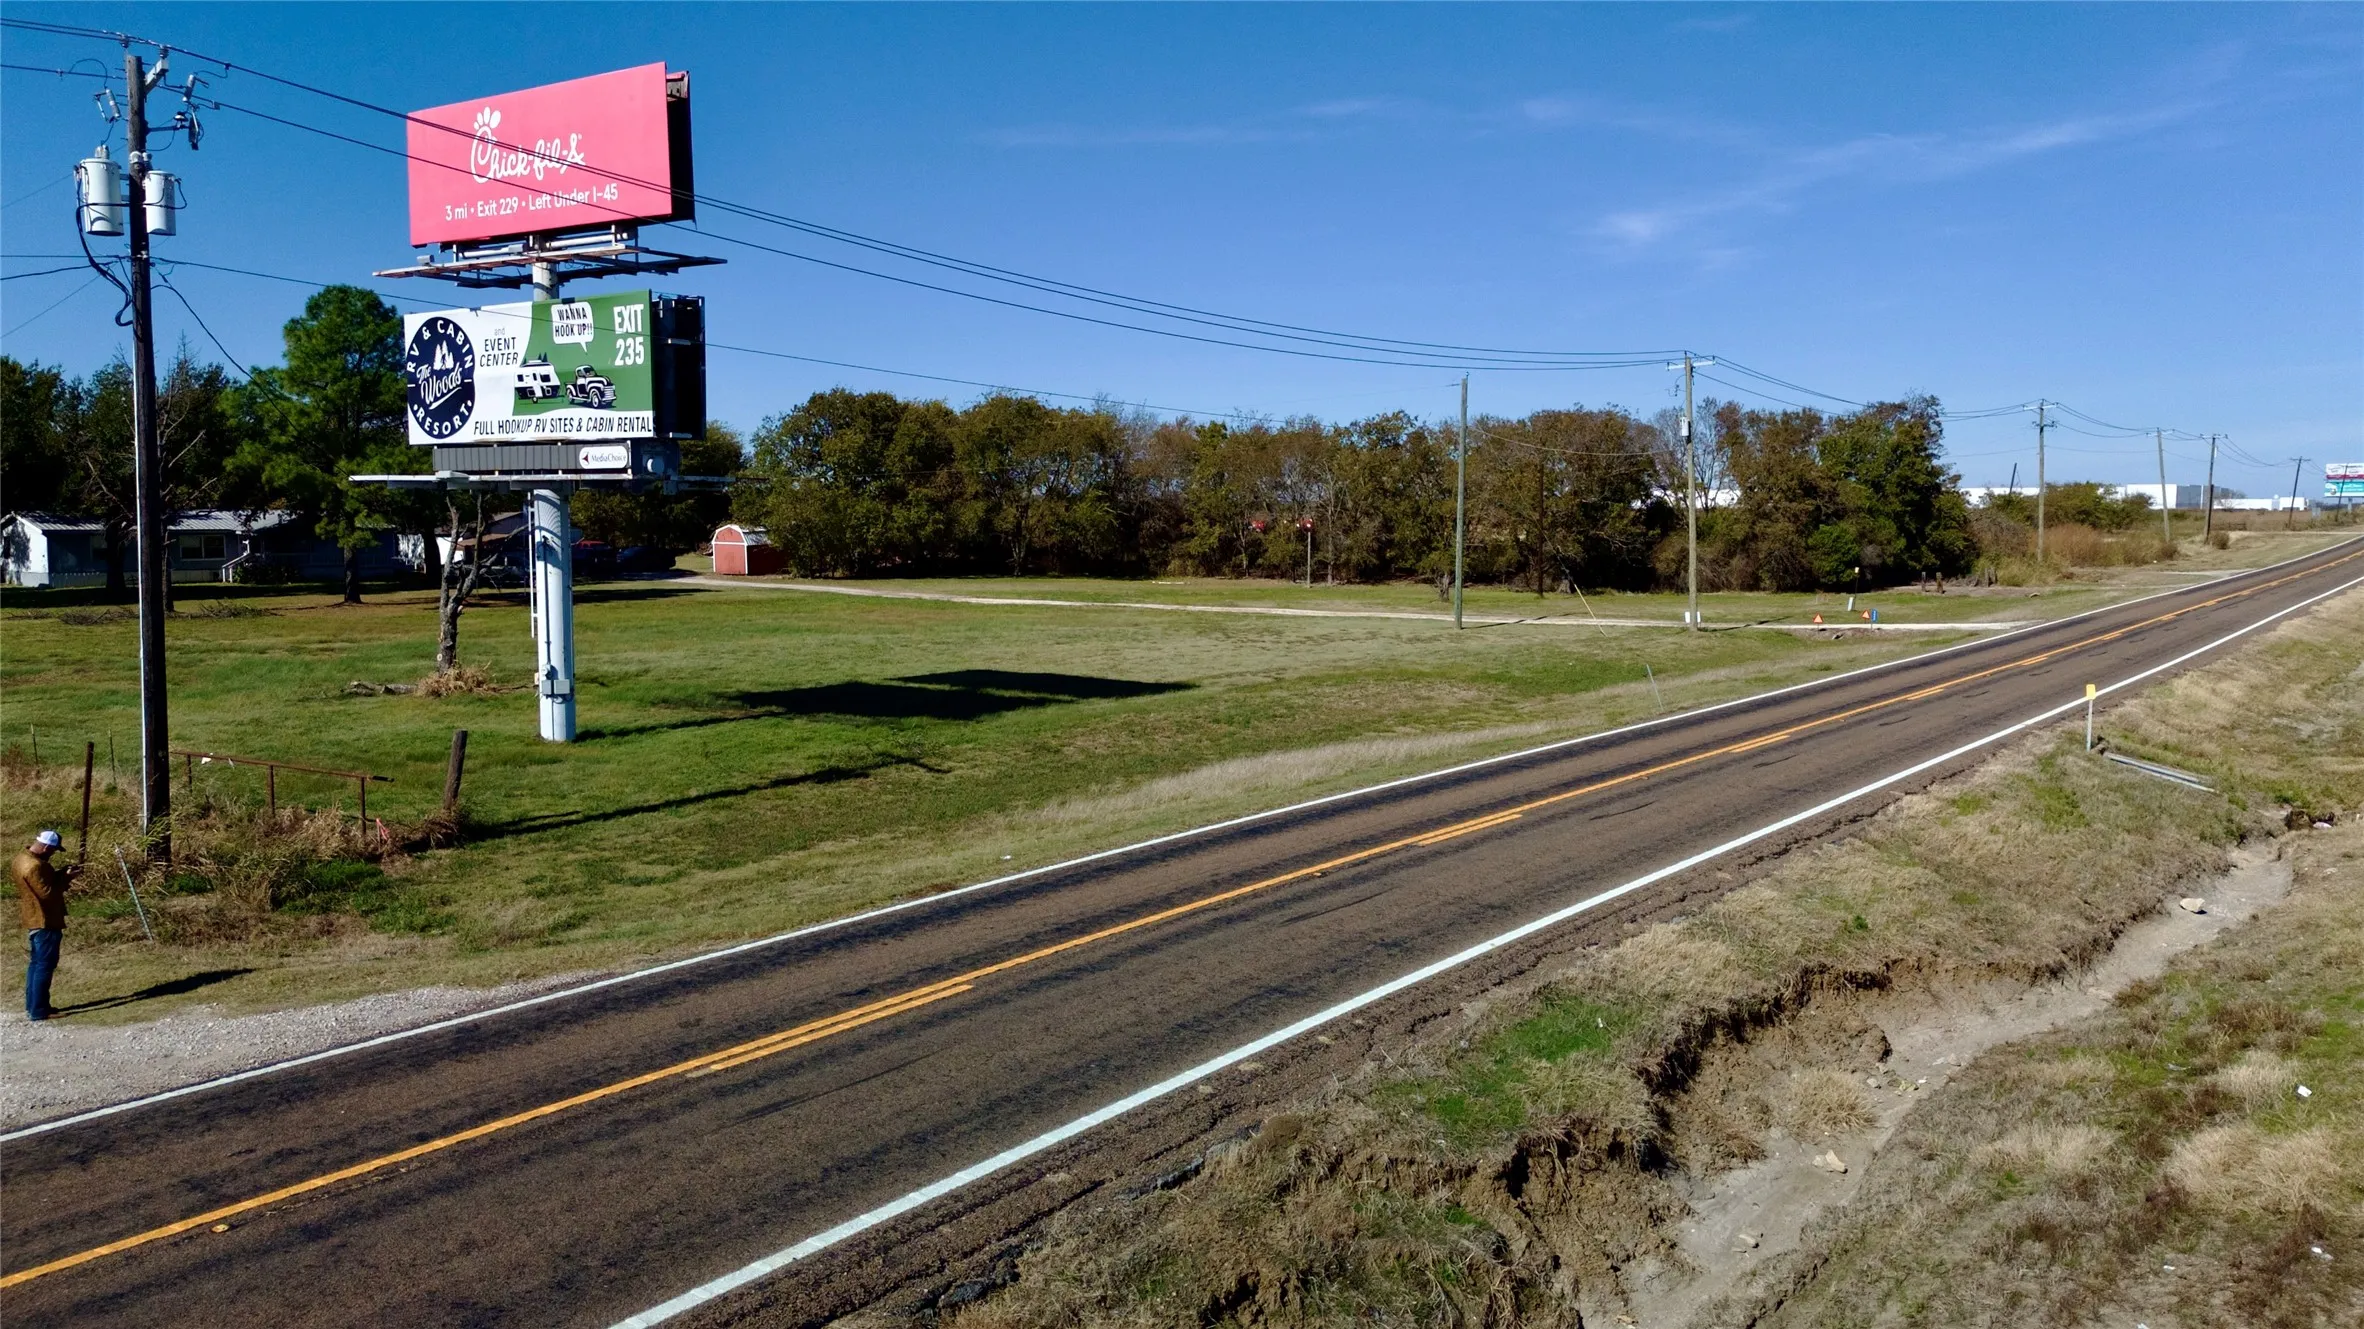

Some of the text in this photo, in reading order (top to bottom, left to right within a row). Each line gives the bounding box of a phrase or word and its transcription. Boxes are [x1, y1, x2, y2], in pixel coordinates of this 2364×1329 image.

[471, 126, 586, 183] Chick-fil-A
[445, 183, 618, 221] 3 mi Exit 229 Left Under I-45
[557, 307, 588, 321] WANNA
[613, 304, 644, 334] EXIT
[494, 327, 506, 335] and
[554, 323, 593, 337] HOOK UP!!
[407, 320, 474, 372] RV & CABIN
[484, 337, 516, 352] EVENT
[614, 337, 645, 366] 235
[480, 352, 519, 367] CENTER
[416, 364, 432, 384] The
[420, 362, 463, 405] Woods
[417, 403, 469, 435] RESORT
[474, 416, 652, 435] FULL HOOKUP RV SITES & CABIN RENTAL
[591, 452, 626, 462] MediaChoice
